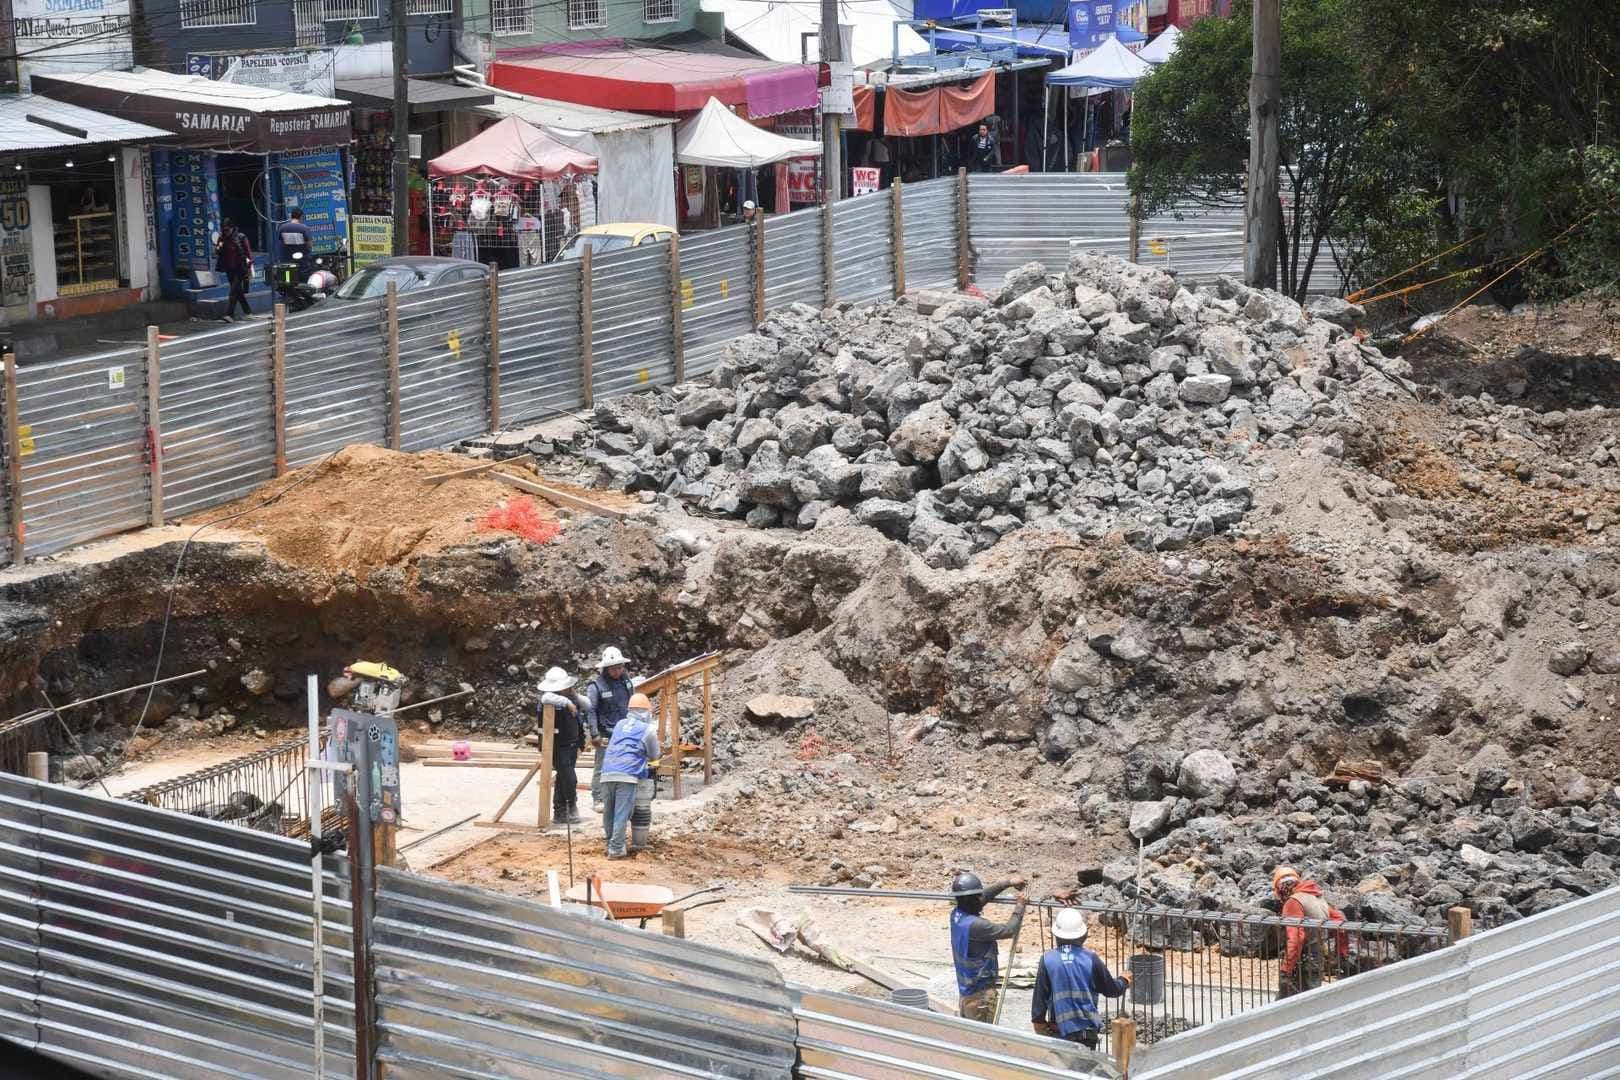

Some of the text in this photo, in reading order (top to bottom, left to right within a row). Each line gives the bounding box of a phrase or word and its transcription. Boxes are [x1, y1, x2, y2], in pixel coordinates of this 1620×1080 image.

[15, 17, 33, 37] PAY
[241, 58, 278, 68] PAPELERIA
[175, 112, 251, 133] "SAMARIA"
[310, 110, 351, 129] "SAMARIA"
[856, 170, 877, 181] WC
[174, 154, 191, 255] COPIAS
